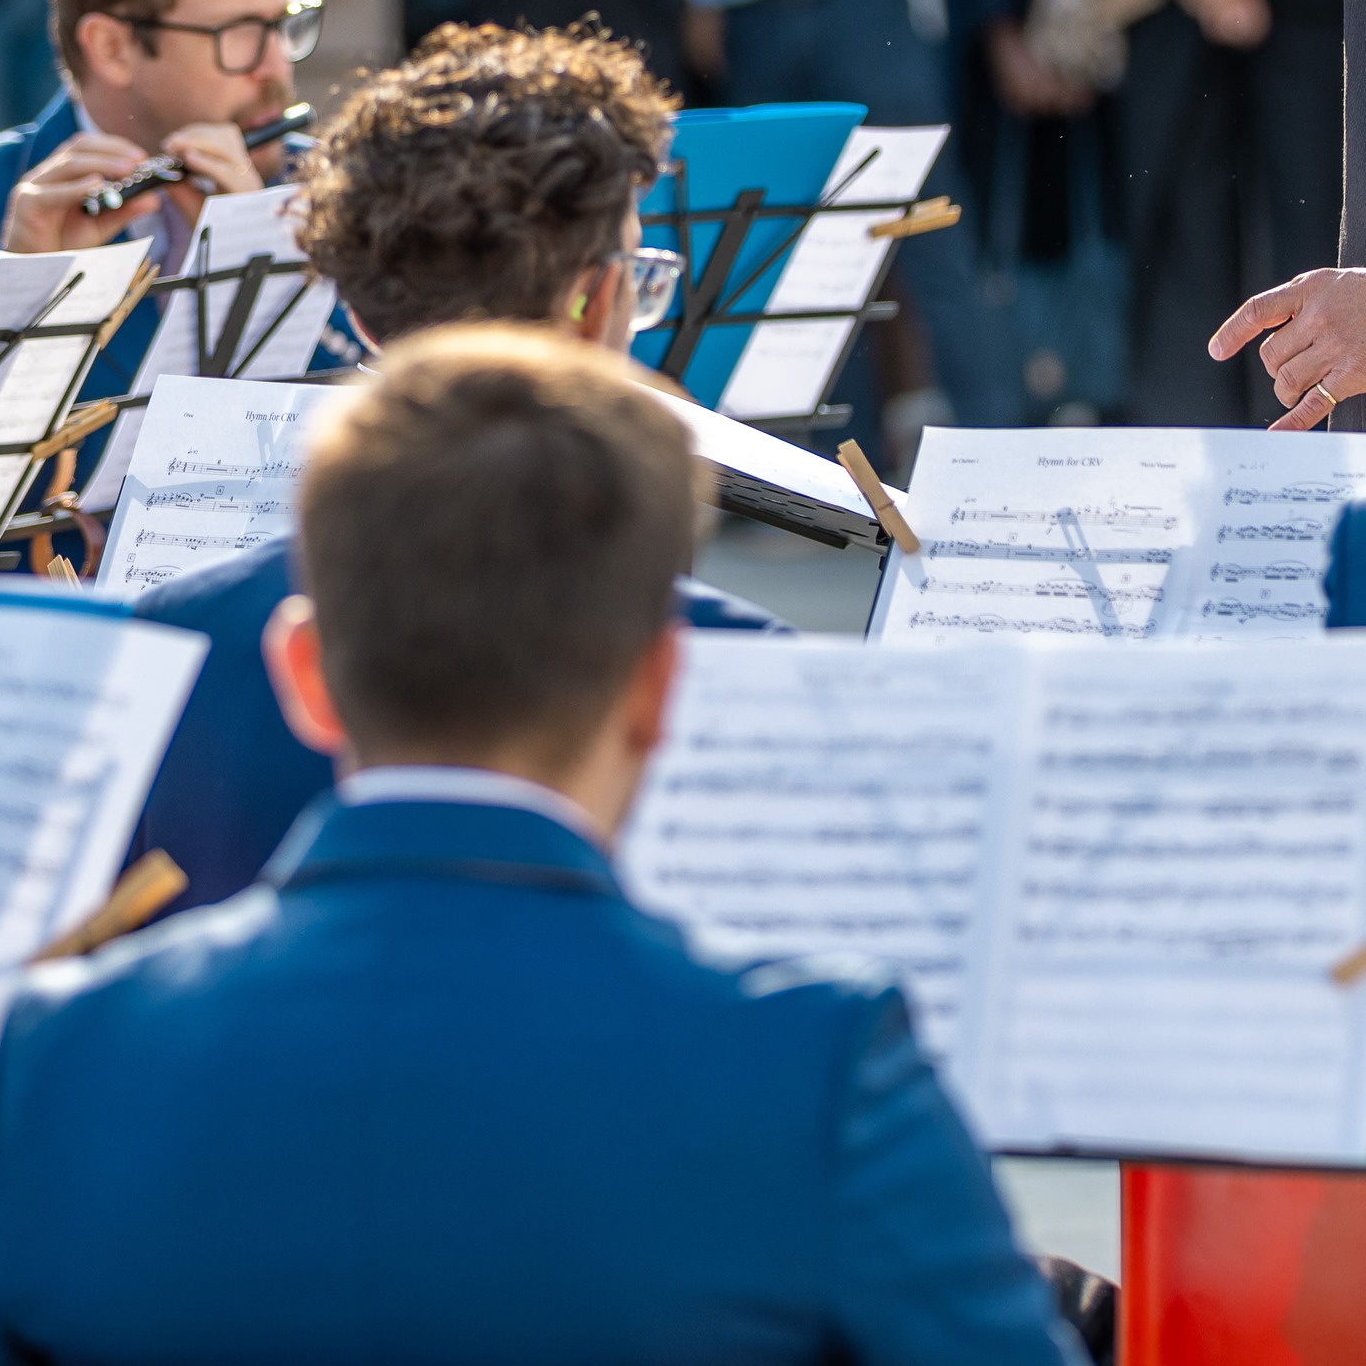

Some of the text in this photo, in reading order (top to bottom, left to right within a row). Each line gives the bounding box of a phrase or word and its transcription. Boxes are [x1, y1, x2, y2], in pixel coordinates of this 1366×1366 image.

[245, 410, 300, 422] Hymn for CRV
[1037, 456, 1104, 468] Hymn for CRV
